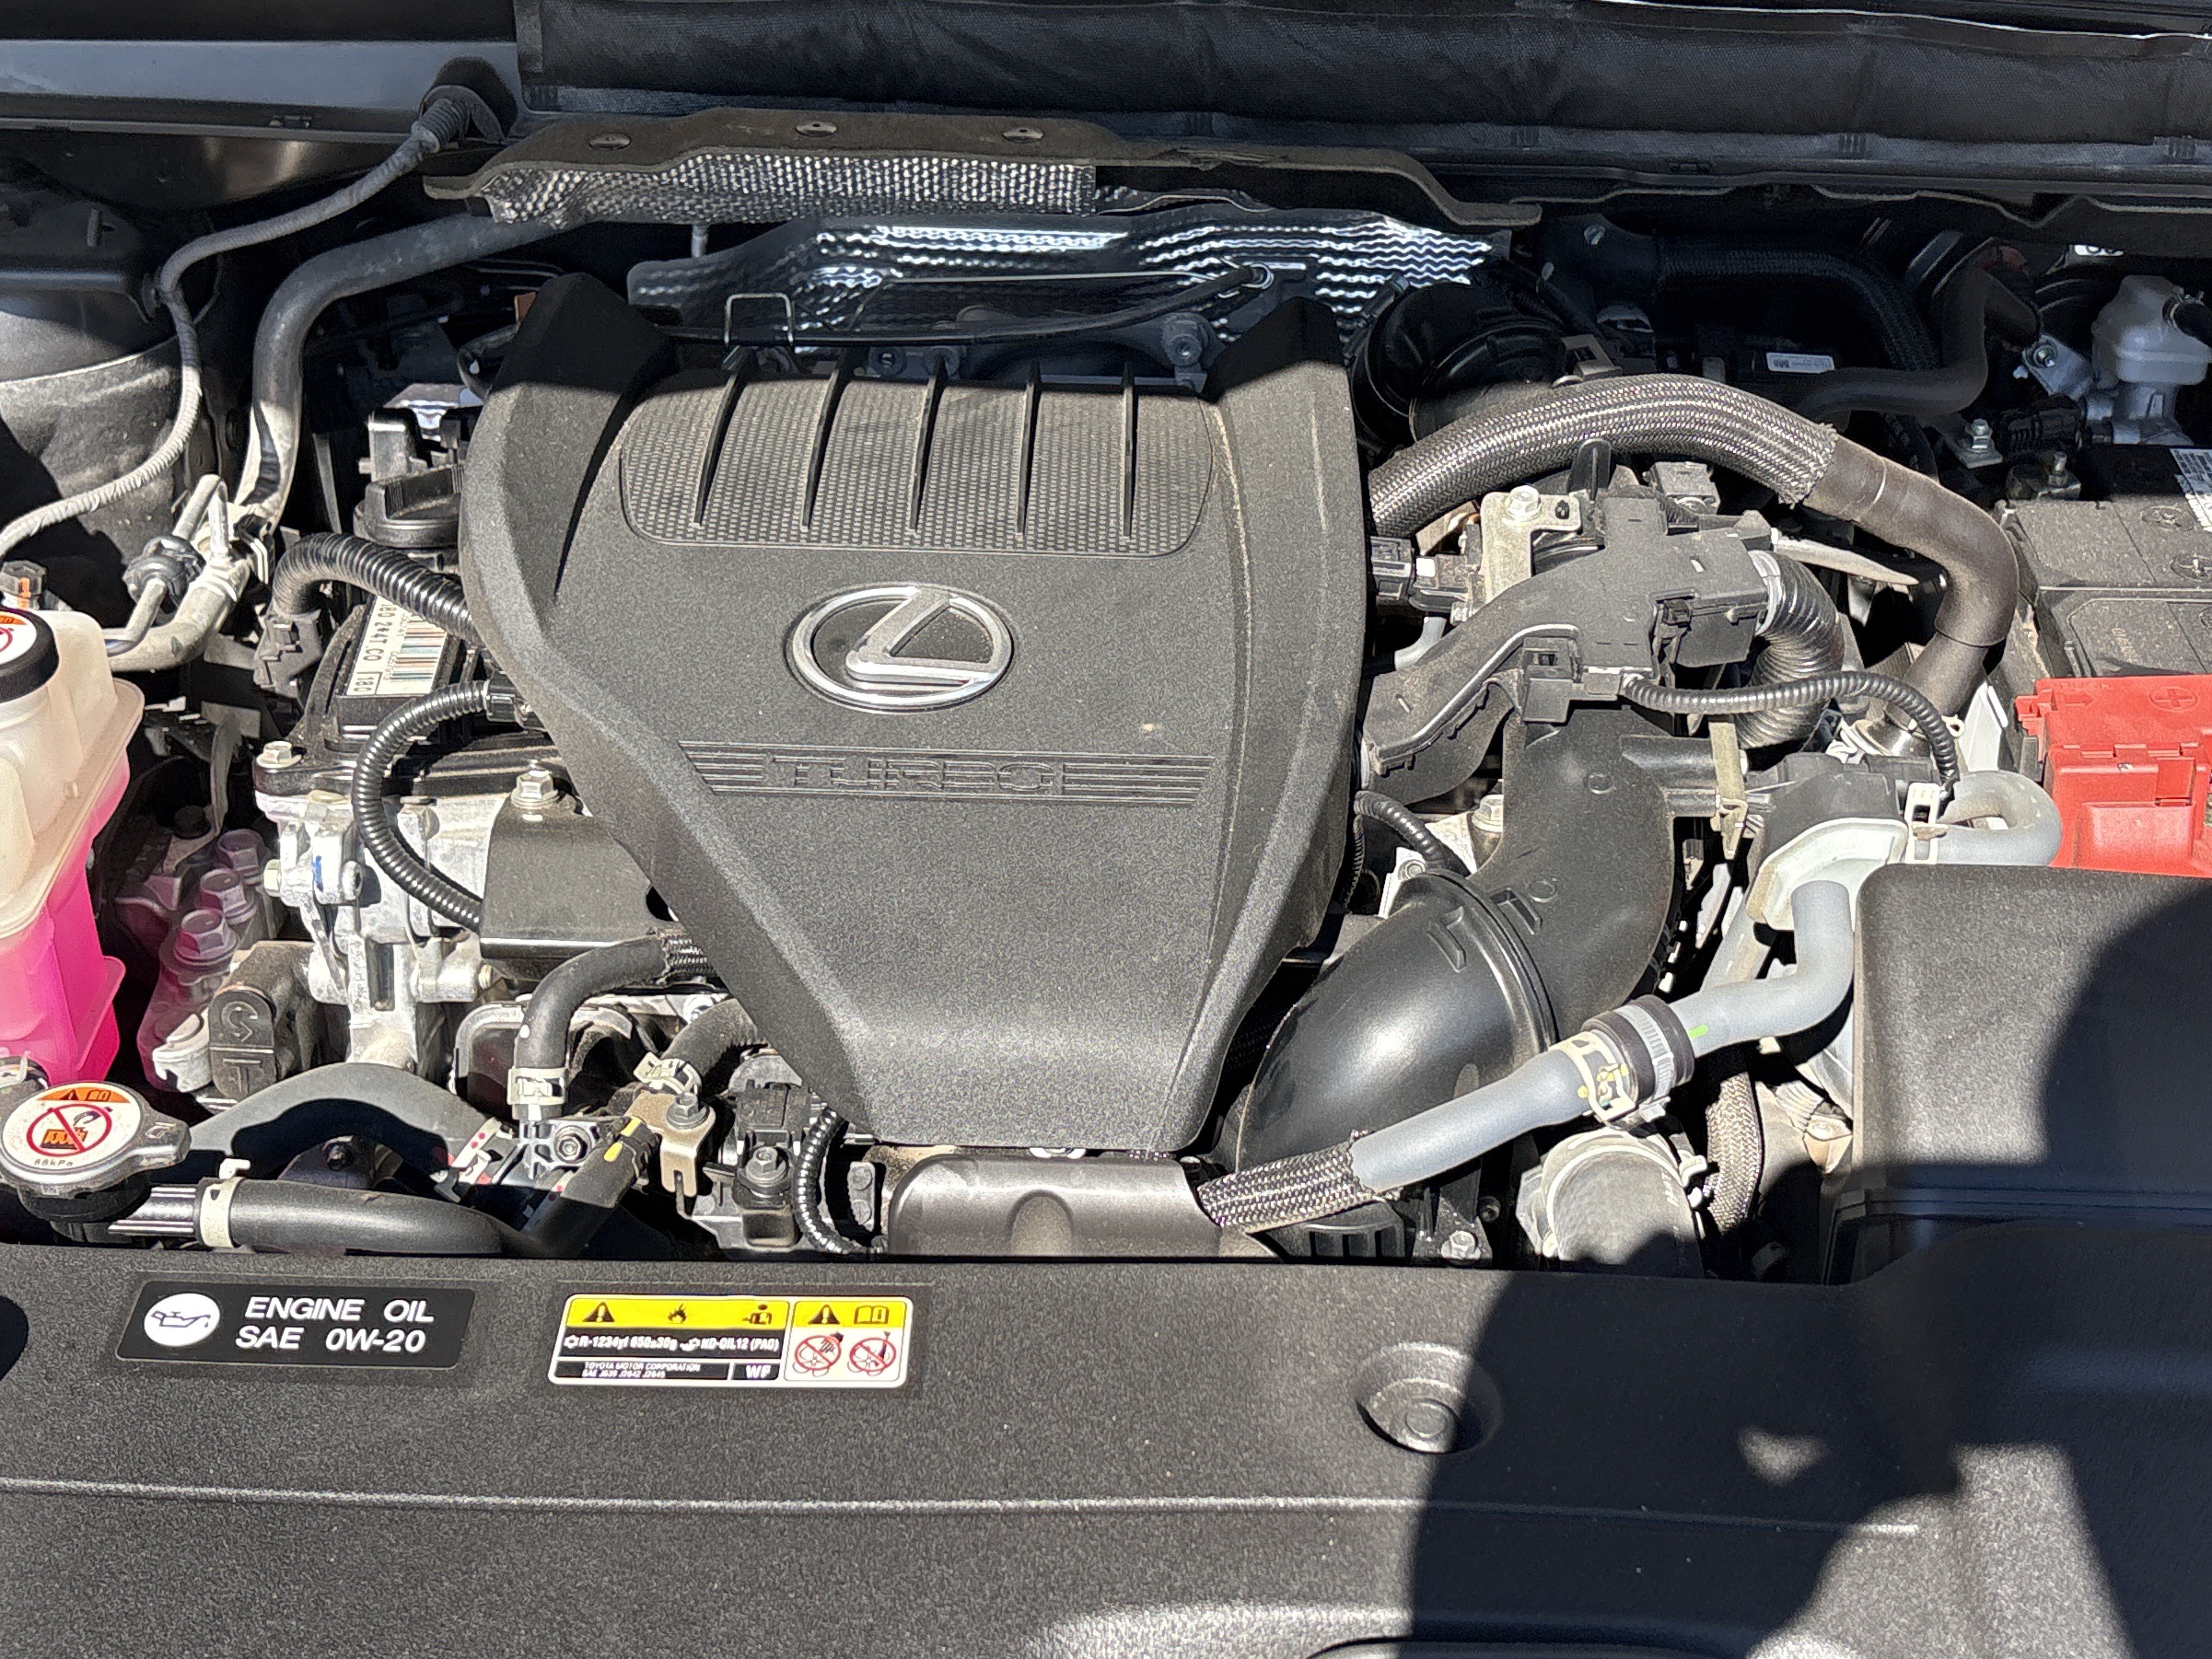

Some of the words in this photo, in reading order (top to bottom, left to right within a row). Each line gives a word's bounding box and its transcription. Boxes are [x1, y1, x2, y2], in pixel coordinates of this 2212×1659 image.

[772, 755, 1056, 791] TURBO
[245, 1296, 365, 1321] ENGINE
[383, 1299, 435, 1323] OIL
[235, 1325, 304, 1350] SAE
[325, 1328, 426, 1353] 0W-20
[584, 1361, 614, 1369] TOYOTA
[616, 1362, 644, 1370] MOTOR
[645, 1363, 701, 1372] CORPORATION
[746, 1364, 771, 1379] WF
